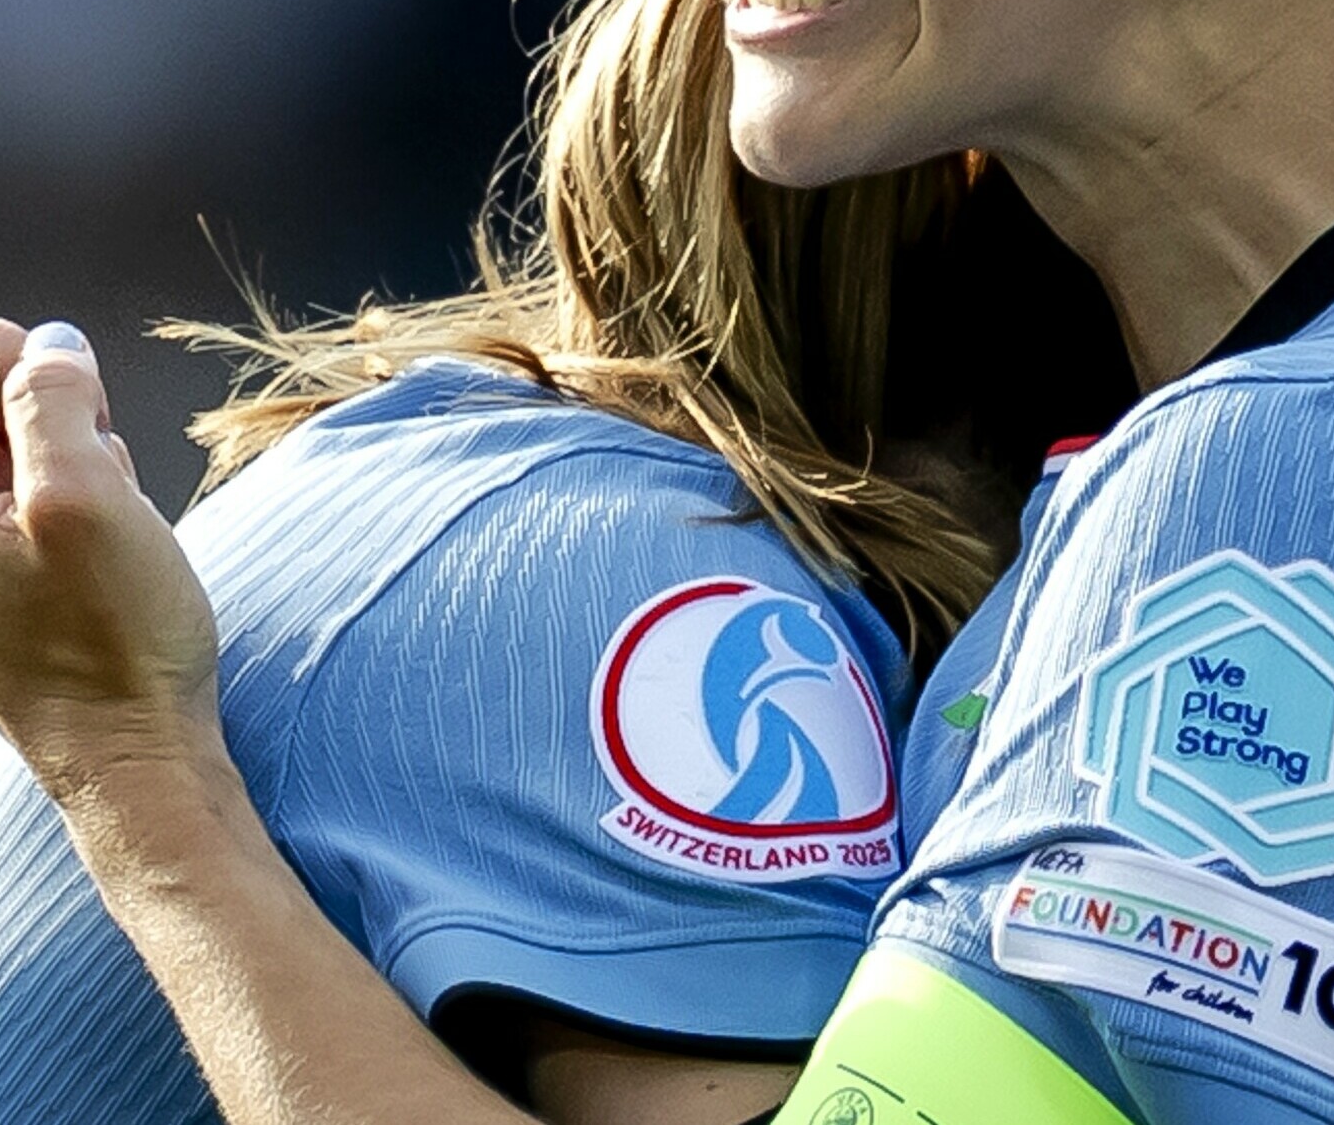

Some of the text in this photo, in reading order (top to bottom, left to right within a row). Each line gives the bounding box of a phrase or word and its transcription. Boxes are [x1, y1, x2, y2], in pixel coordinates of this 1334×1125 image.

[1188, 656, 1246, 688] We
[1181, 690, 1267, 736] Play
[1176, 726, 1310, 785] Strong
[617, 806, 892, 870] SWITZERLAND 2025
[1030, 847, 1085, 874] UEFA
[1008, 886, 1270, 983] FOUNDATION
[1146, 970, 1255, 1024] for children
